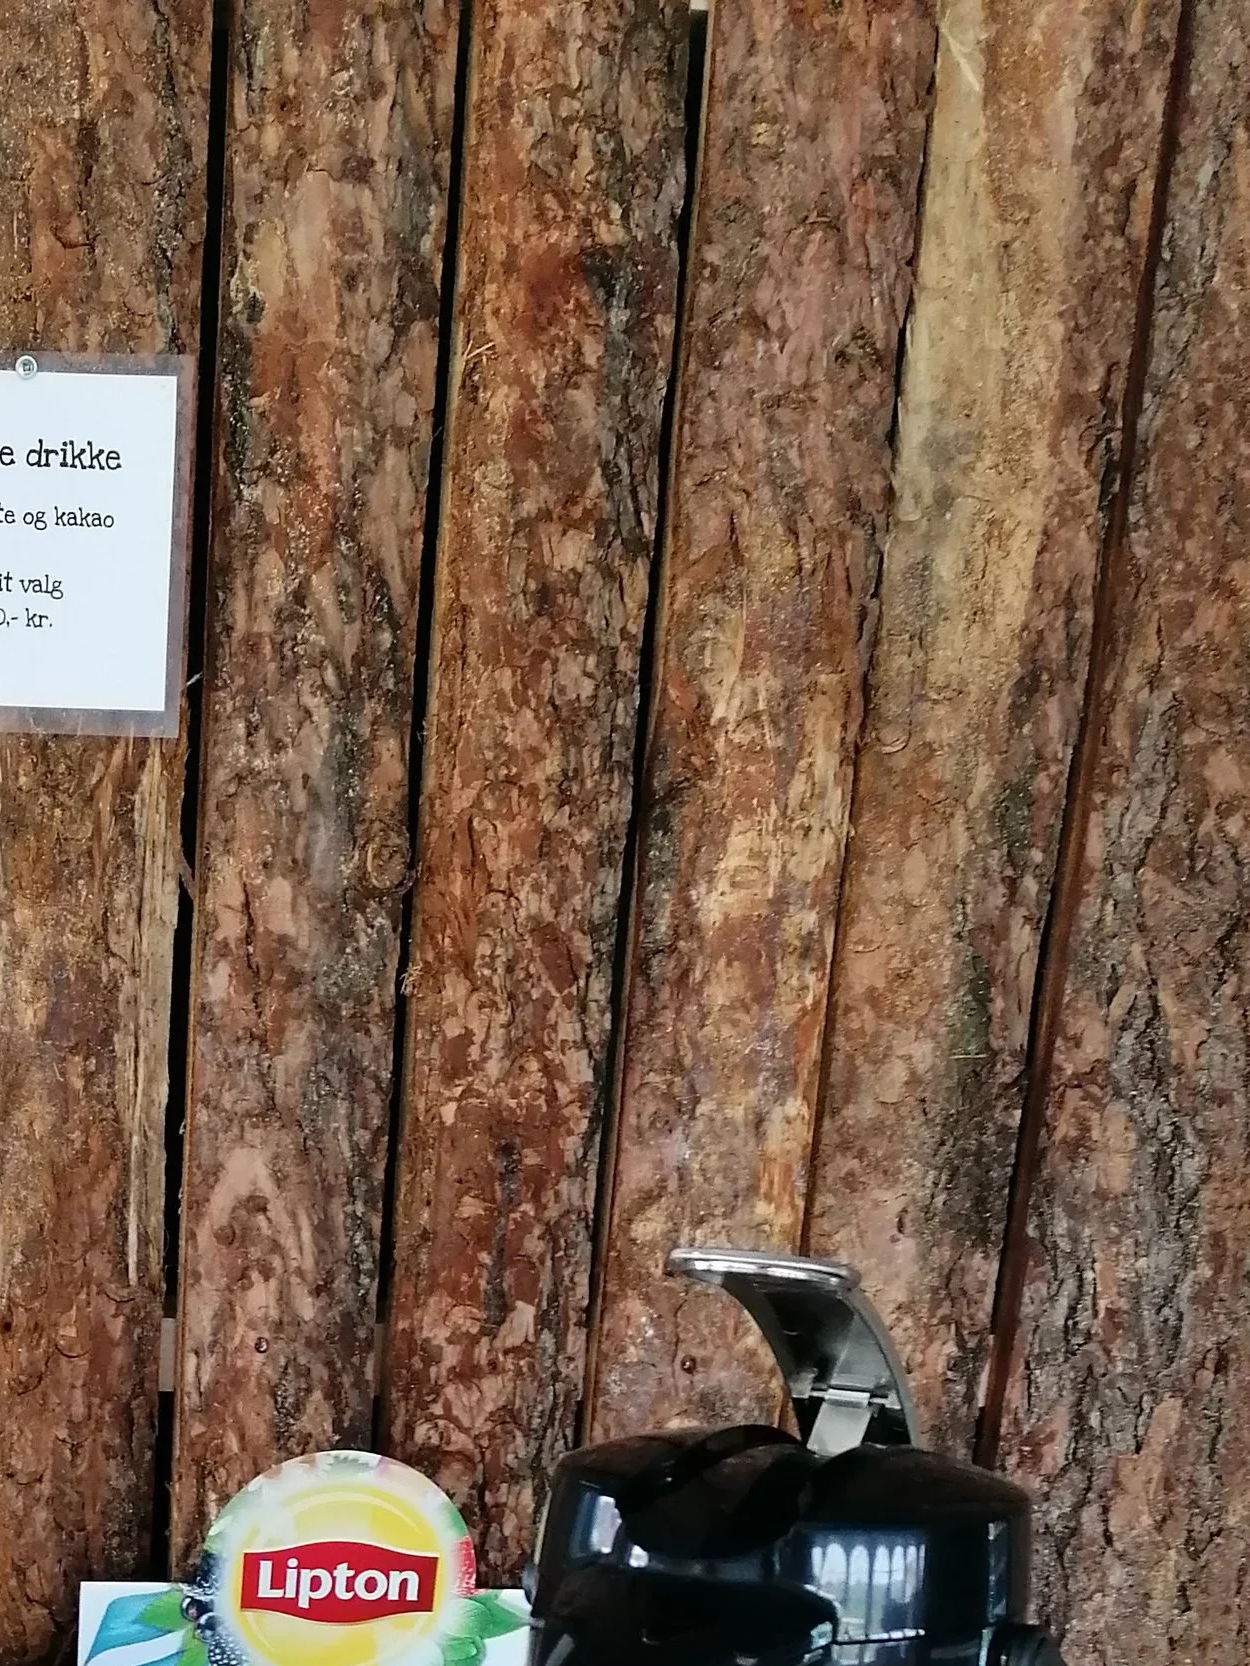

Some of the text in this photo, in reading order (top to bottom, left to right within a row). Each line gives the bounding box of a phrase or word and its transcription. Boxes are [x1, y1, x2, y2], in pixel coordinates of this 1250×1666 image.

[25, 438, 123, 471] drikke
[22, 510, 48, 531] og
[53, 506, 115, 529] kakao
[19, 575, 64, 600] valg
[25, 607, 53, 629] kr.
[256, 1557, 420, 1610] Lipton
